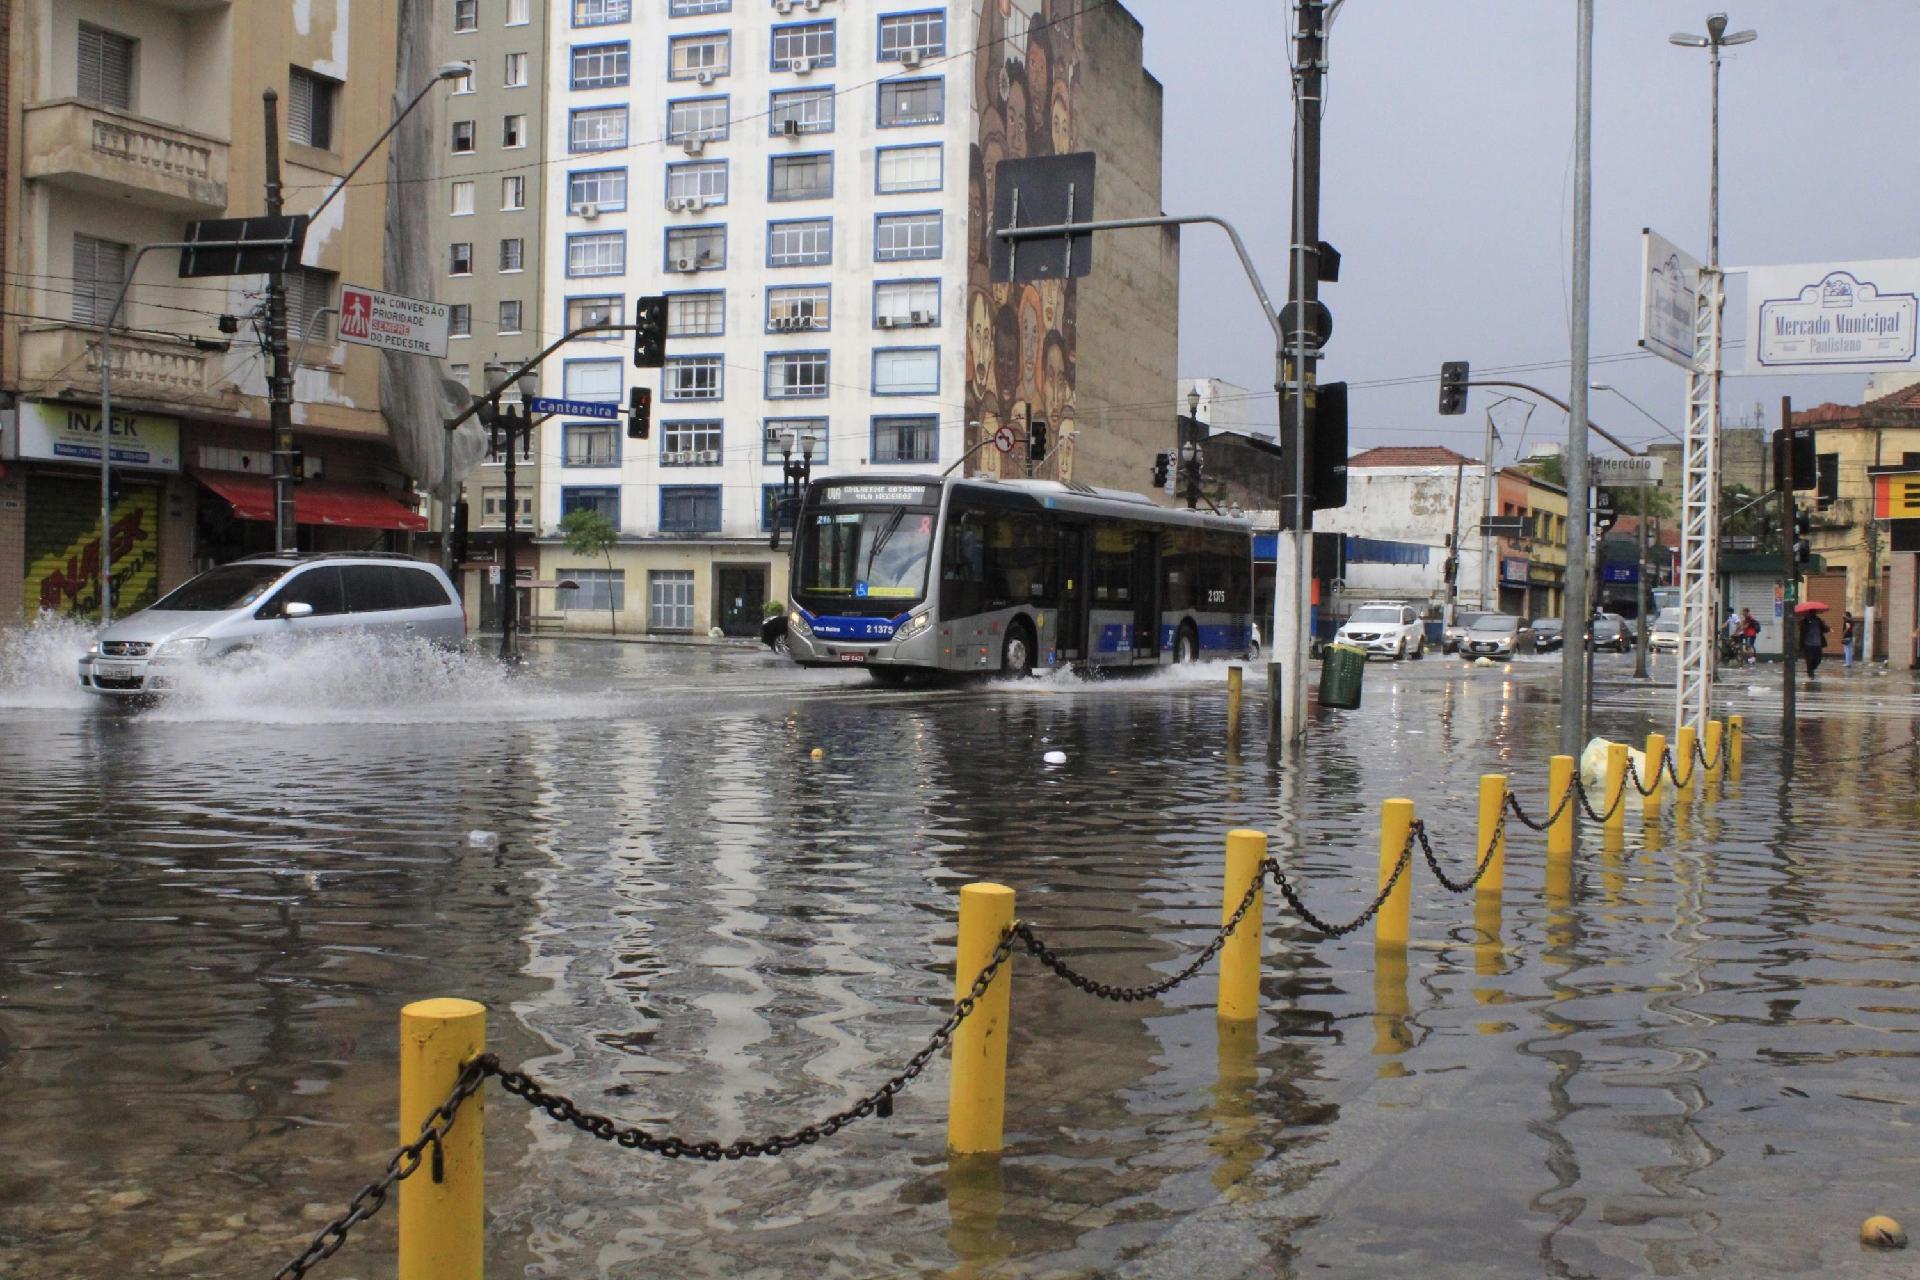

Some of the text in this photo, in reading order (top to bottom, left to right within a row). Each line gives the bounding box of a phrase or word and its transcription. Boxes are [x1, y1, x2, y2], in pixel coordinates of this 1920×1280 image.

[373, 295, 445, 318] NA CONVERSÃO
[372, 307, 425, 327] PRIORIDADE
[1776, 311, 1900, 336] Mercado Municipal
[371, 320, 411, 337] SEMPRE
[370, 333, 431, 352] DO PEDESTRE
[1809, 337, 1861, 353] Paulistano
[538, 400, 612, 417] Cantareira
[1603, 458, 1651, 470] Mercúrio
[873, 624, 894, 635] 1375
